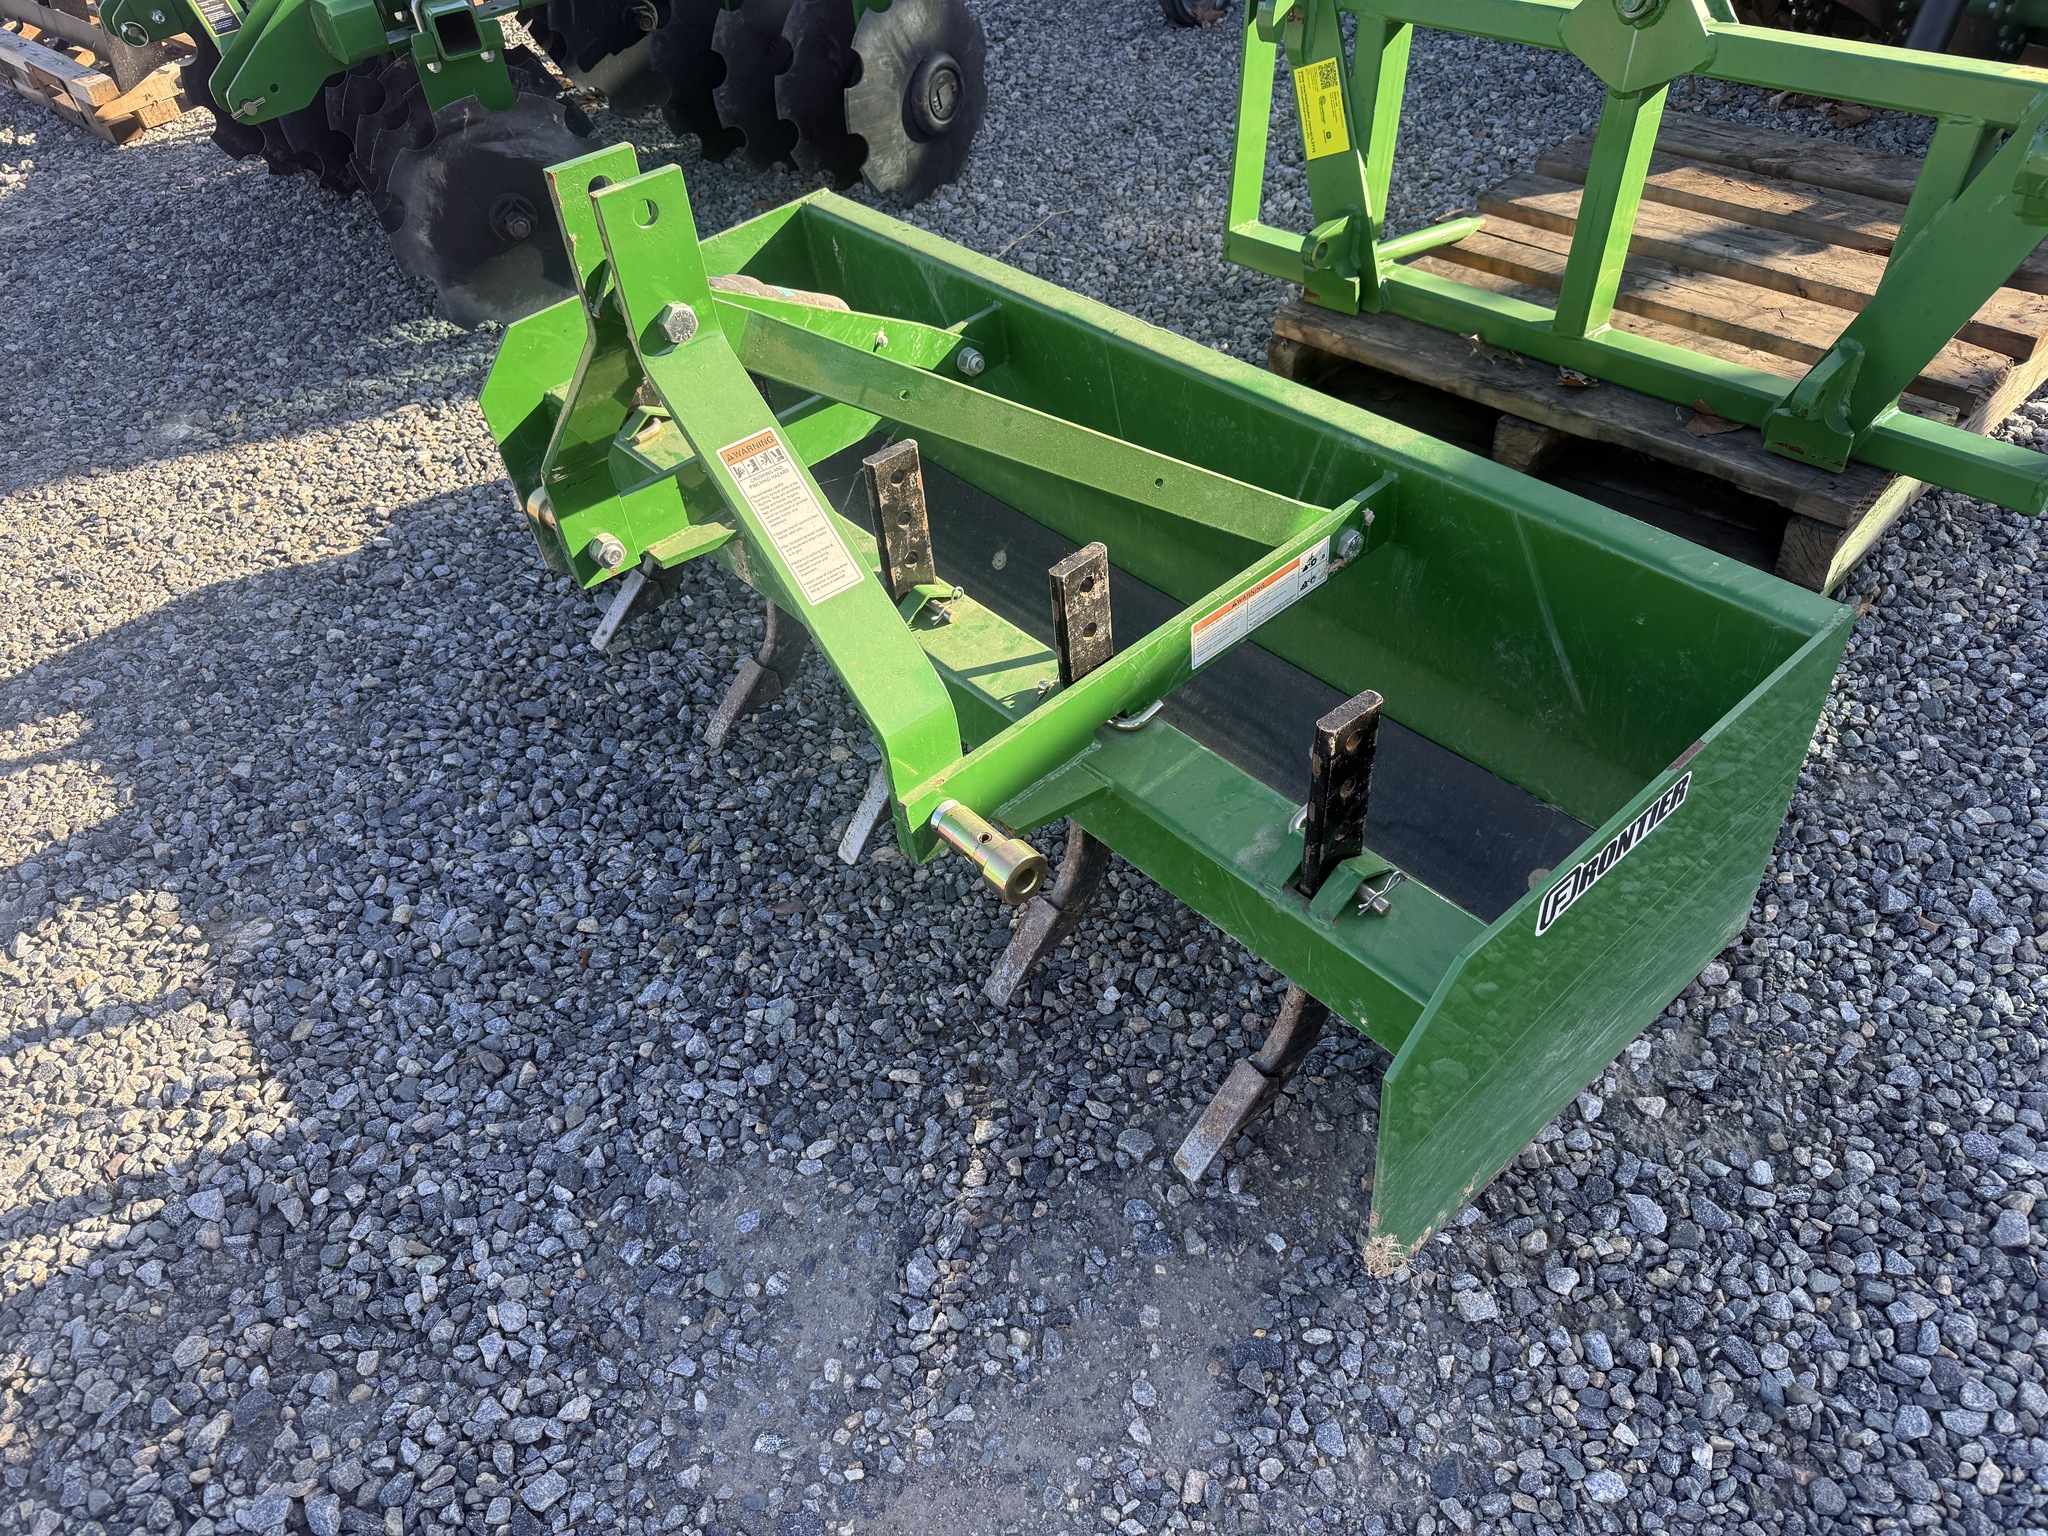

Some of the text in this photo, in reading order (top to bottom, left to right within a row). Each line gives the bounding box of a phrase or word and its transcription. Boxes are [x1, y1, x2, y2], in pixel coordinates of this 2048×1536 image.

[732, 436, 774, 458] WARNING
[749, 468, 789, 489] PINCHING HAZARD
[750, 470, 773, 483] CRUSHING
[1238, 583, 1266, 605] WARNING
[1540, 775, 1689, 931] FRONTIER
